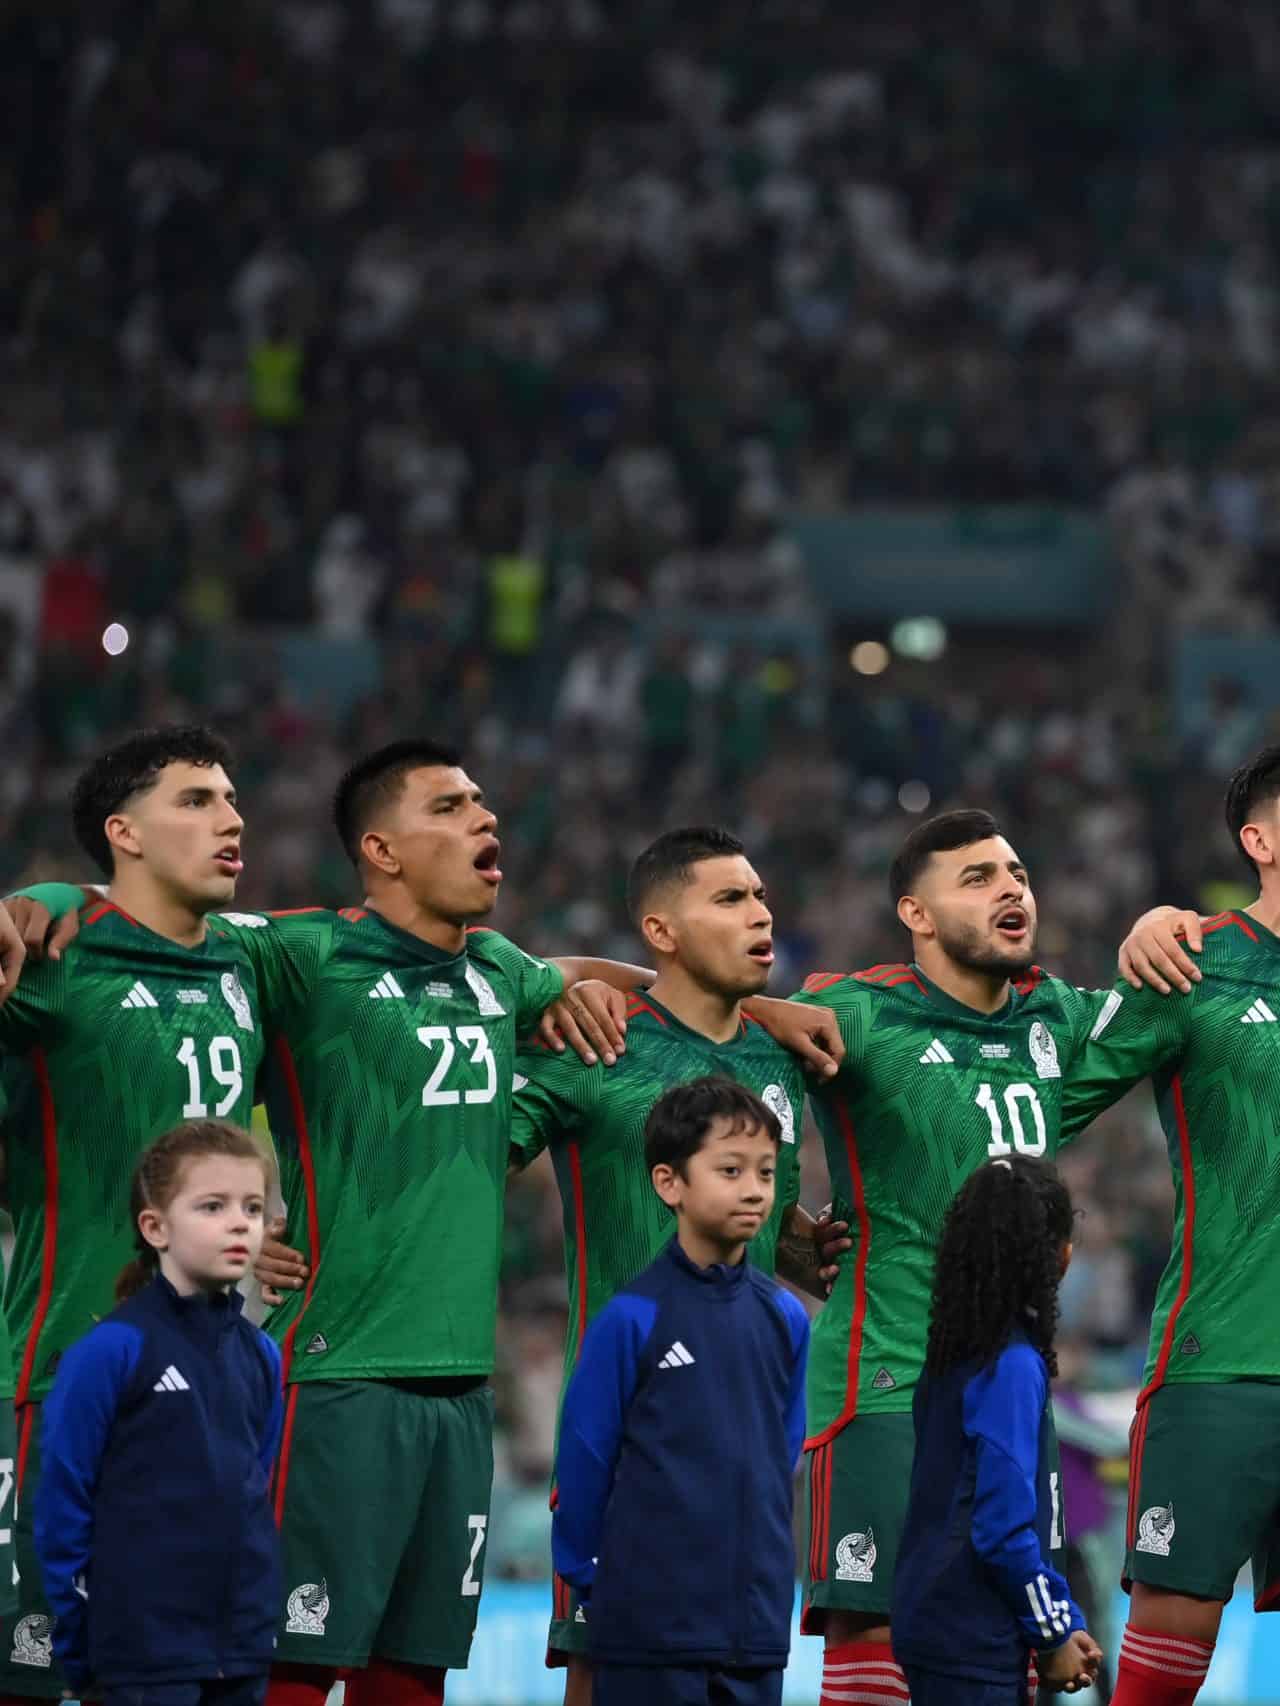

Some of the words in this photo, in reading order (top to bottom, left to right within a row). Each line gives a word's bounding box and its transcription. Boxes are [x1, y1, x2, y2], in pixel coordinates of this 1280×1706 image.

[176, 1036, 243, 1119] 19
[416, 1025, 497, 1106] 23
[975, 1083, 1047, 1157] 10
